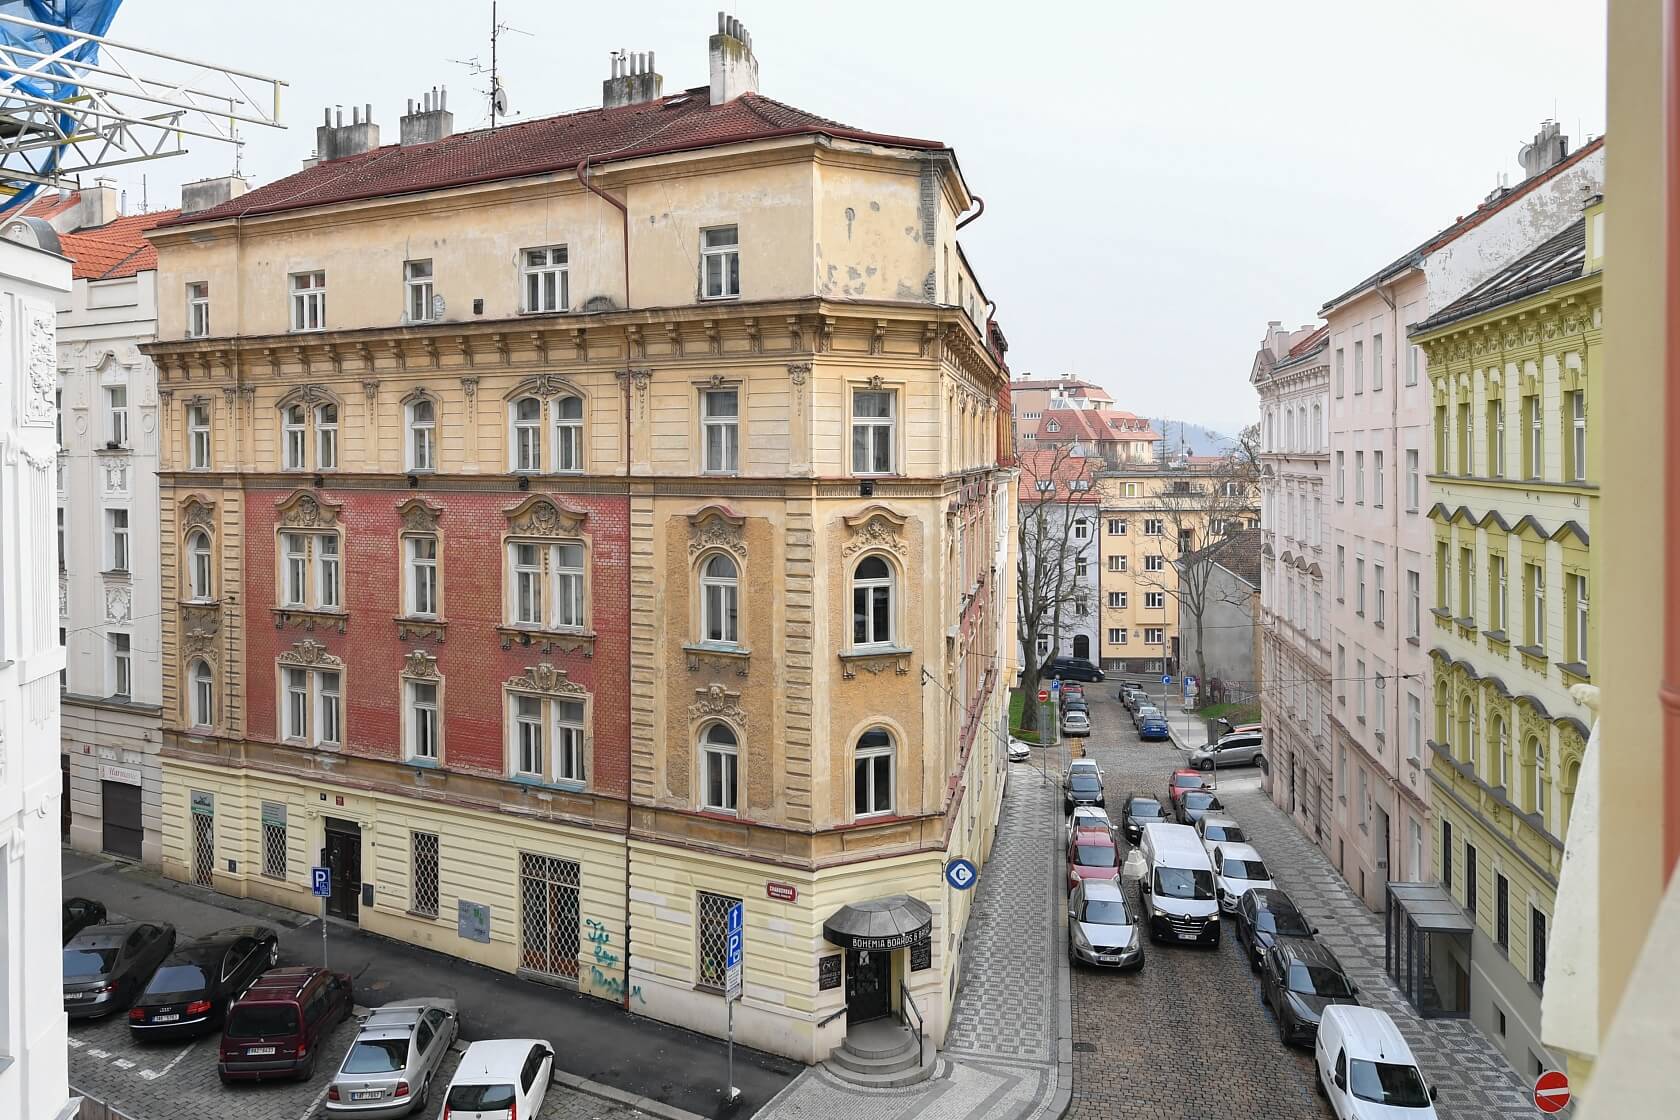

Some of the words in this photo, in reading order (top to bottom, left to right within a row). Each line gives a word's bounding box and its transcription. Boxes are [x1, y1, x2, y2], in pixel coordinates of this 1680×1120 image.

[315, 871, 326, 887] P
[956, 868, 966, 881] C
[730, 936, 739, 957] P
[852, 938, 885, 948] BOHEMIA
[887, 935, 913, 947] BOARDS
